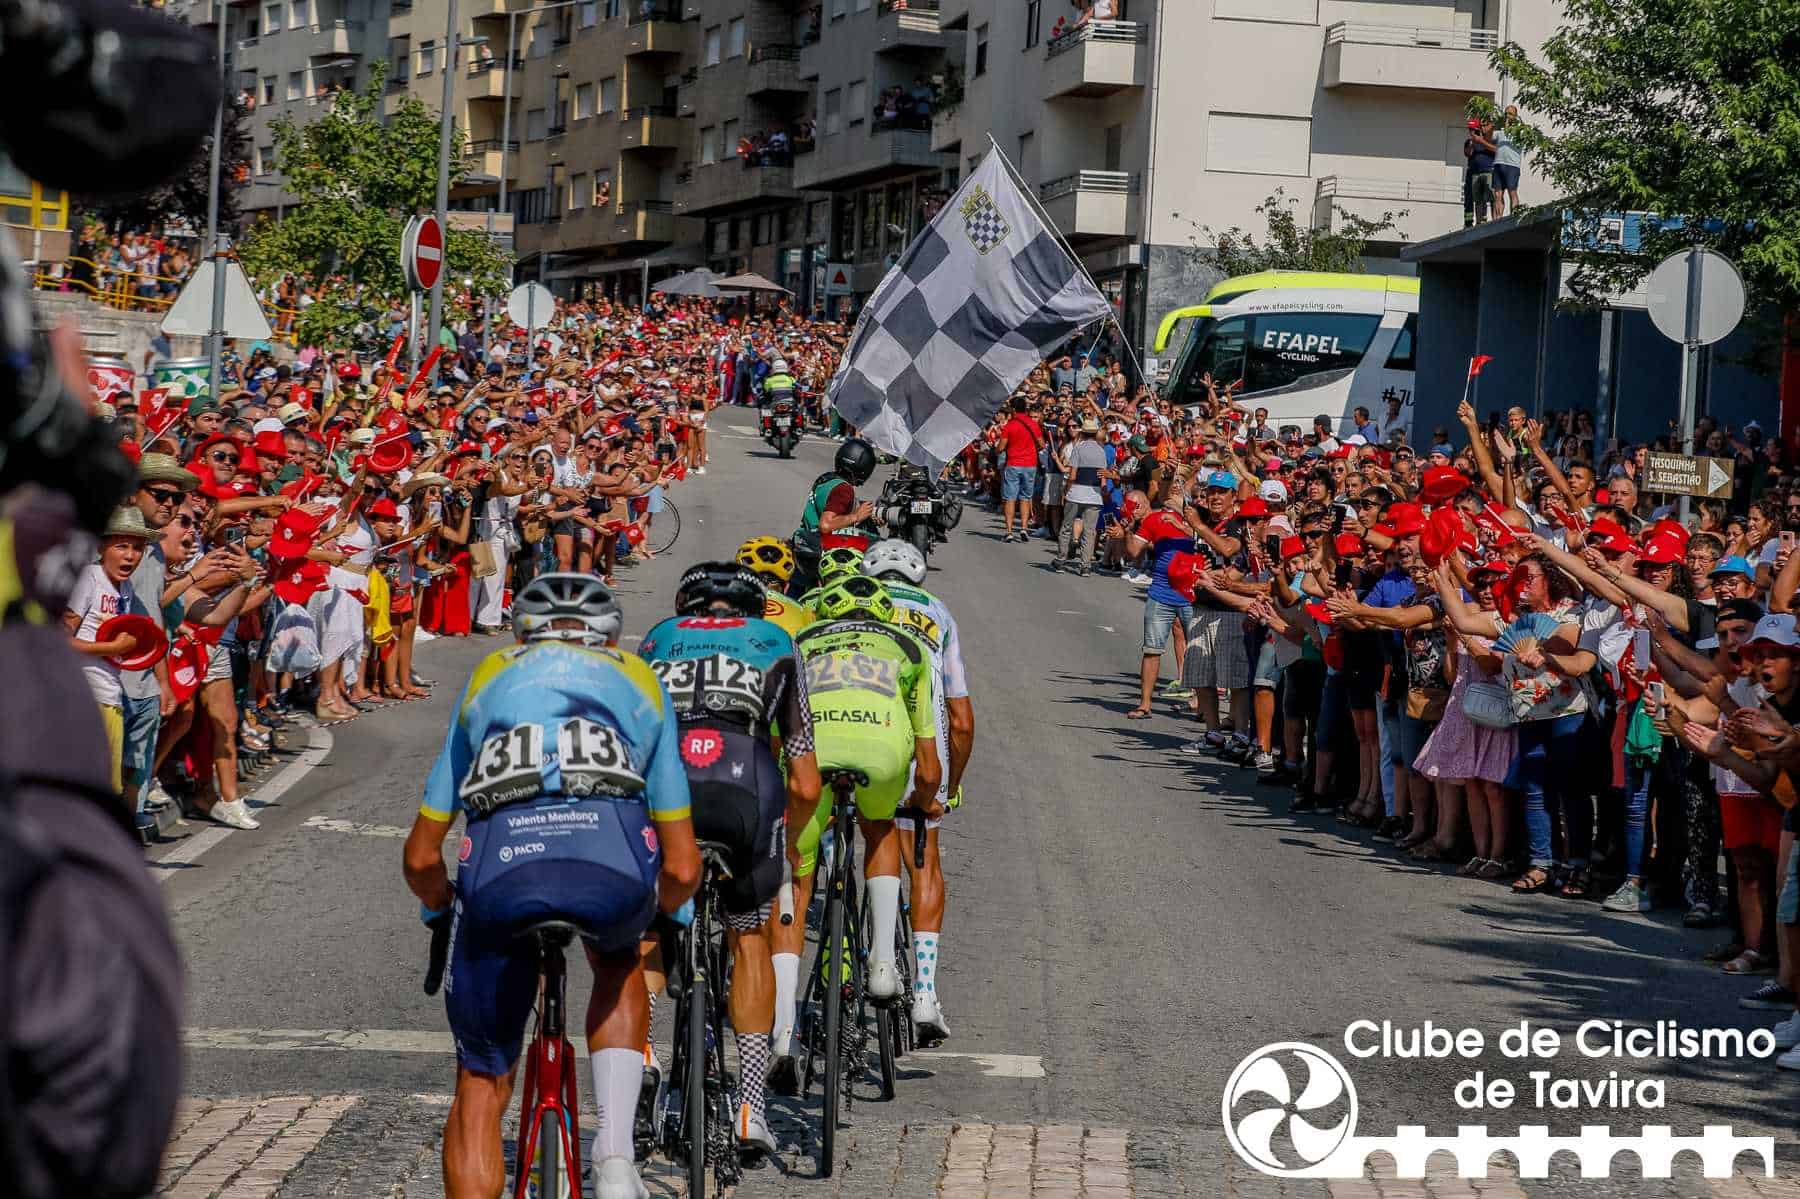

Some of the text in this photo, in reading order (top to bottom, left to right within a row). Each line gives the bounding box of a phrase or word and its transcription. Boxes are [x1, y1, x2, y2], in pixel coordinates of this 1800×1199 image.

[1263, 330, 1341, 354] EFAPEL
[811, 709, 882, 725] SICASAL
[690, 738, 716, 755] RP
[465, 724, 537, 789] 131
[507, 813, 546, 828] Valente
[547, 810, 600, 825] Mendonça
[514, 842, 546, 856] PACTO
